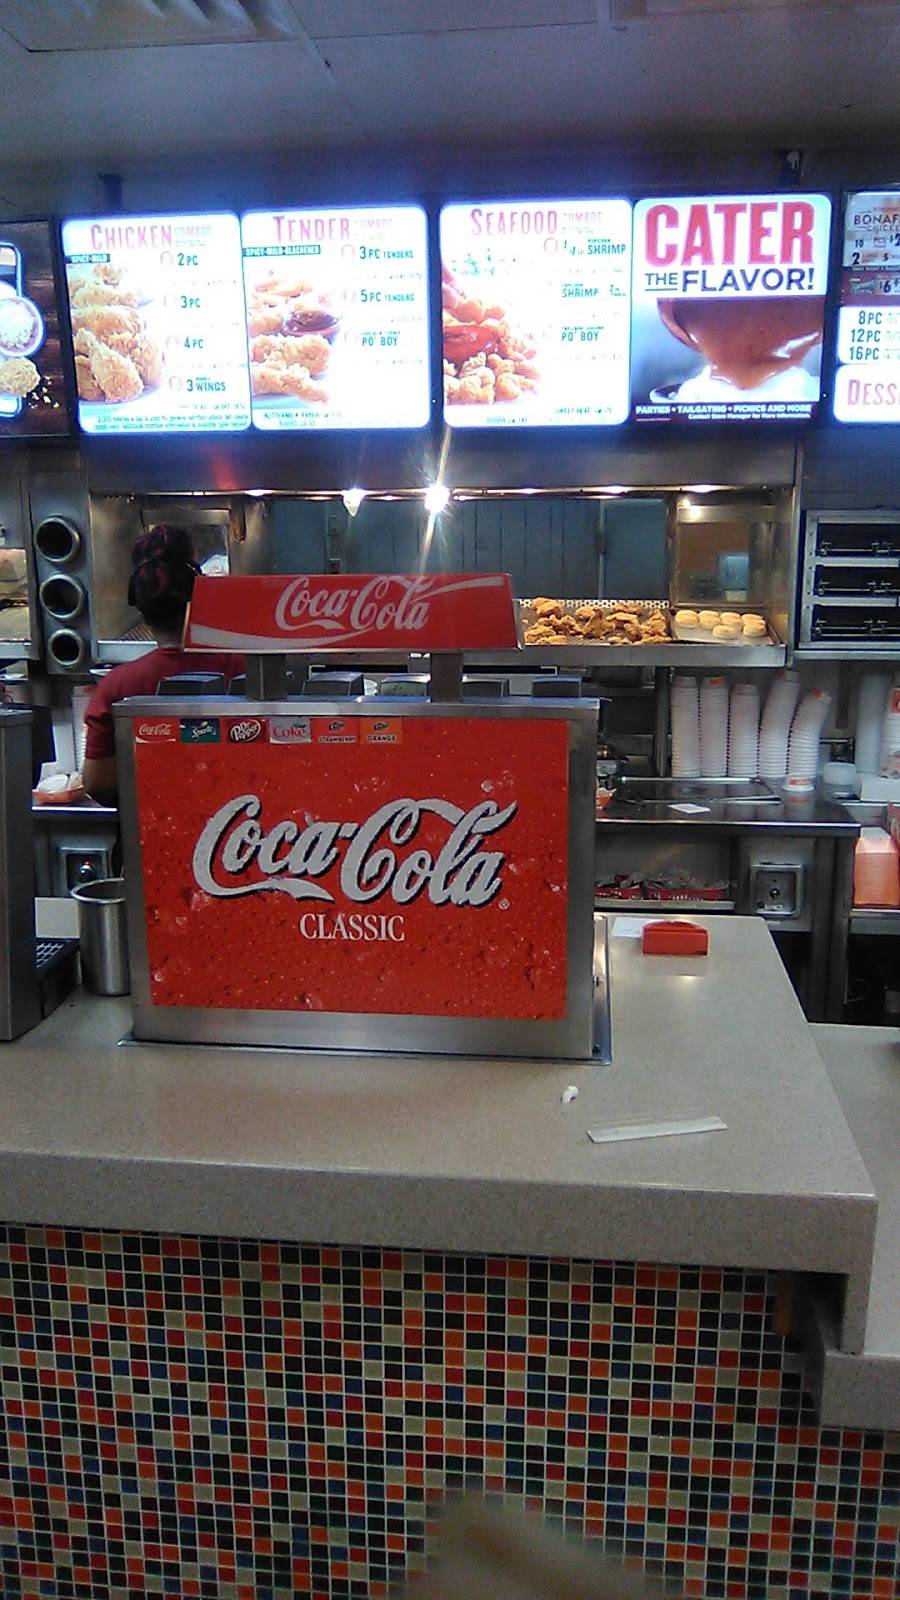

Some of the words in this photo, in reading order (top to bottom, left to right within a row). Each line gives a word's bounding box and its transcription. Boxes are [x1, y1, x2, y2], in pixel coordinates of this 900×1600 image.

[272, 216, 350, 242] TENDER
[471, 208, 557, 235] SEAFOOD
[645, 202, 815, 267] CATER
[90, 224, 173, 251] CHICKEN
[587, 244, 626, 255] SHRIMP
[562, 288, 599, 299] SHRIMP
[645, 272, 678, 286] THE
[682, 268, 815, 293] FLAVOR!
[380, 336, 398, 346] BOY
[580, 331, 599, 341] BOY
[186, 379, 194, 392] 3
[195, 381, 226, 392] WINGS
[847, 379, 900, 406] DESS
[275, 576, 435, 631] Coca-Cola
[192, 794, 518, 908] Coca-Cola
[299, 913, 406, 942] CLASSIC
